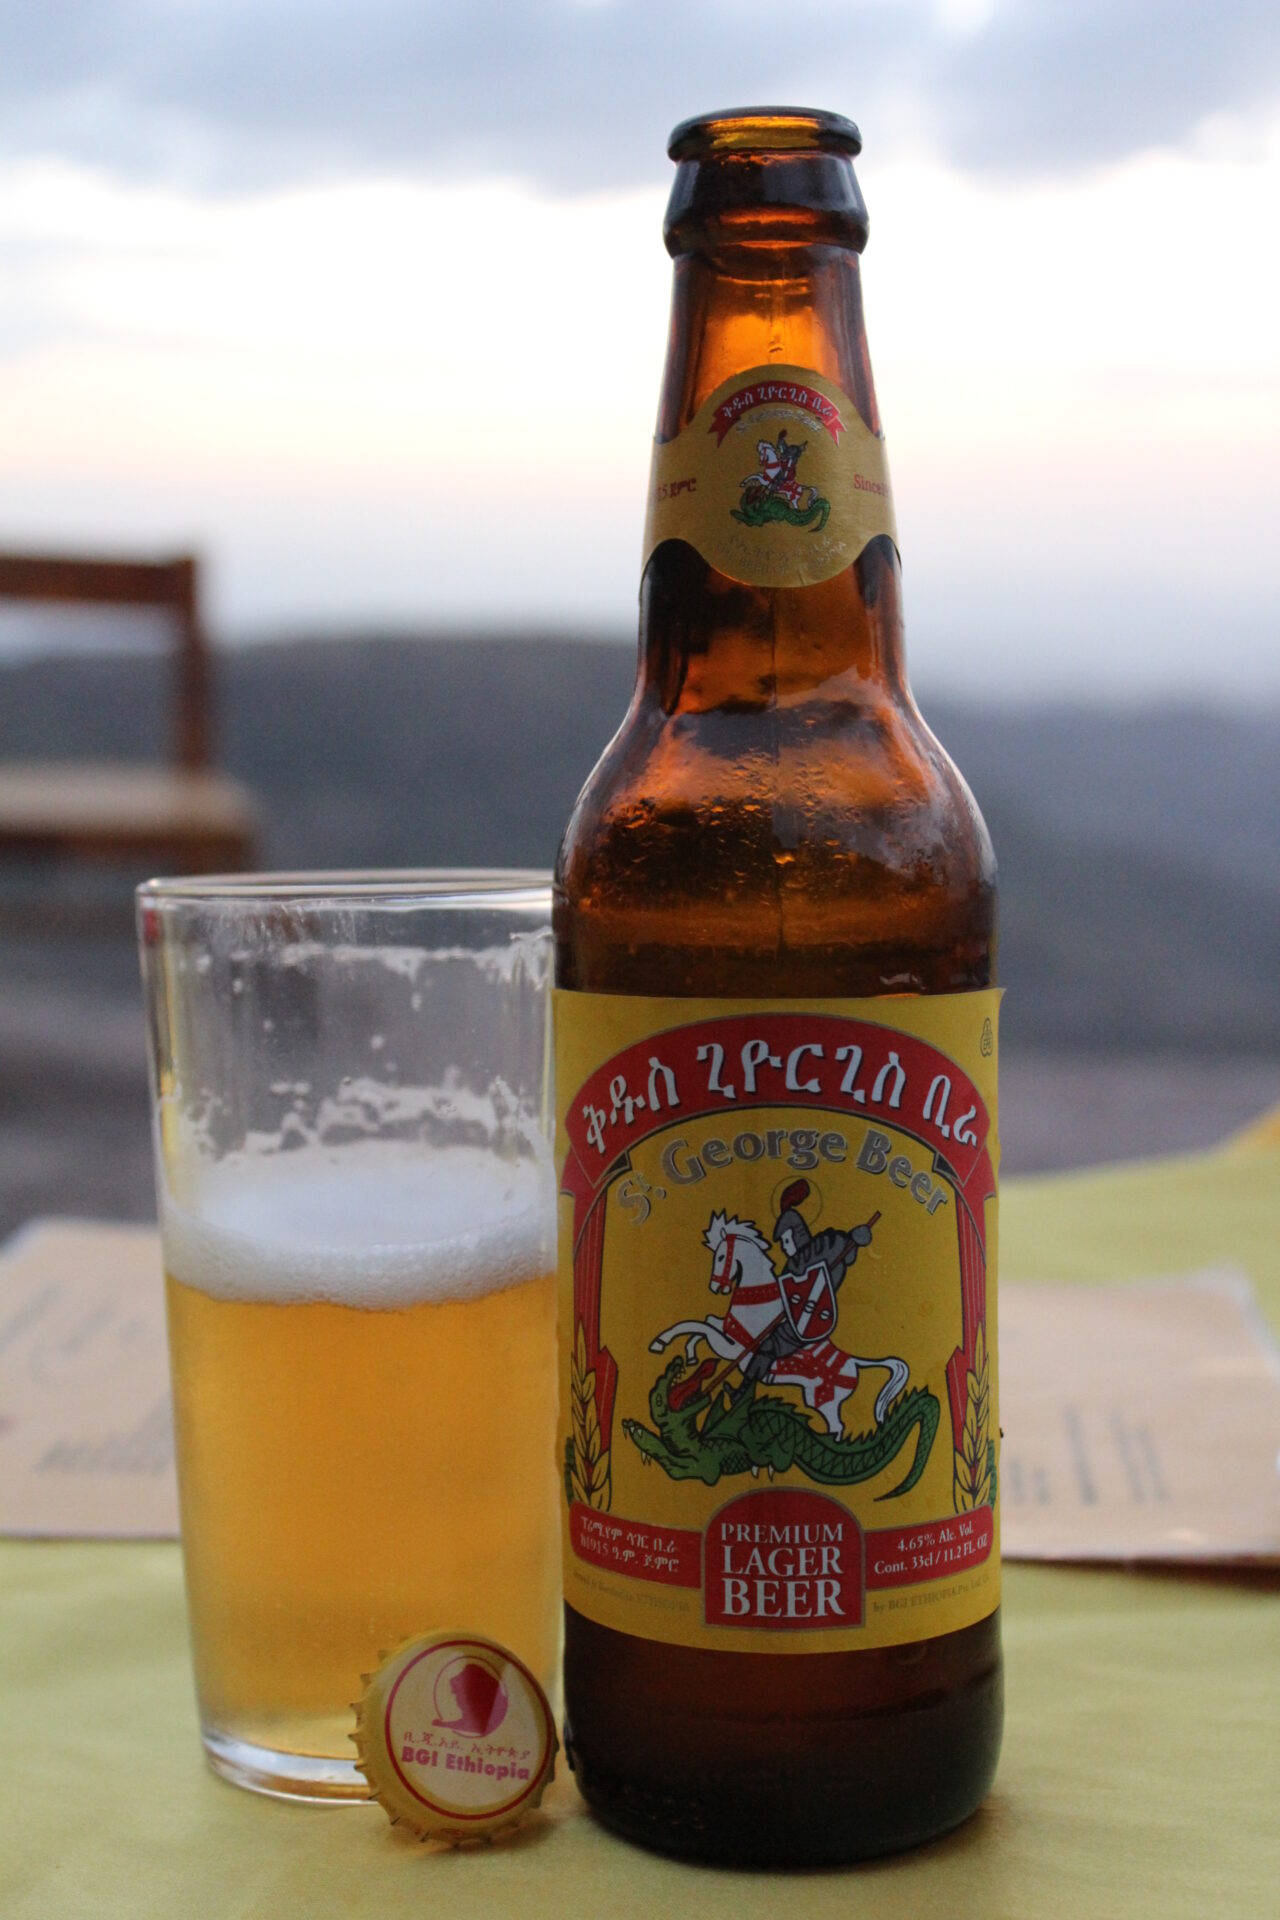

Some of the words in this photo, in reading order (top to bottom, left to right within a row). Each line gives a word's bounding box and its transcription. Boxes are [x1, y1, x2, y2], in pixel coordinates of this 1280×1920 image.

[812, 397, 833, 417] ቢራ
[582, 1055, 680, 1154] ቅዱስ
[696, 1039, 906, 1109] ጊዮርጊስ
[922, 1074, 977, 1148] ቢራ
[616, 1170, 667, 1225] St.
[661, 1127, 848, 1186] George
[855, 1129, 949, 1216] Beer
[720, 1522, 844, 1545] PREMIUM
[897, 1533, 936, 1552] 4.65%
[938, 1528, 956, 1544] Alc.
[721, 1545, 844, 1577] LAGER
[874, 1560, 908, 1575] Cont.
[912, 1552, 933, 1569] 33cl
[944, 1545, 962, 1563] 11.2
[721, 1578, 846, 1618] BEER
[401, 1746, 439, 1768] BGI
[445, 1753, 530, 1781] Ethiopia
